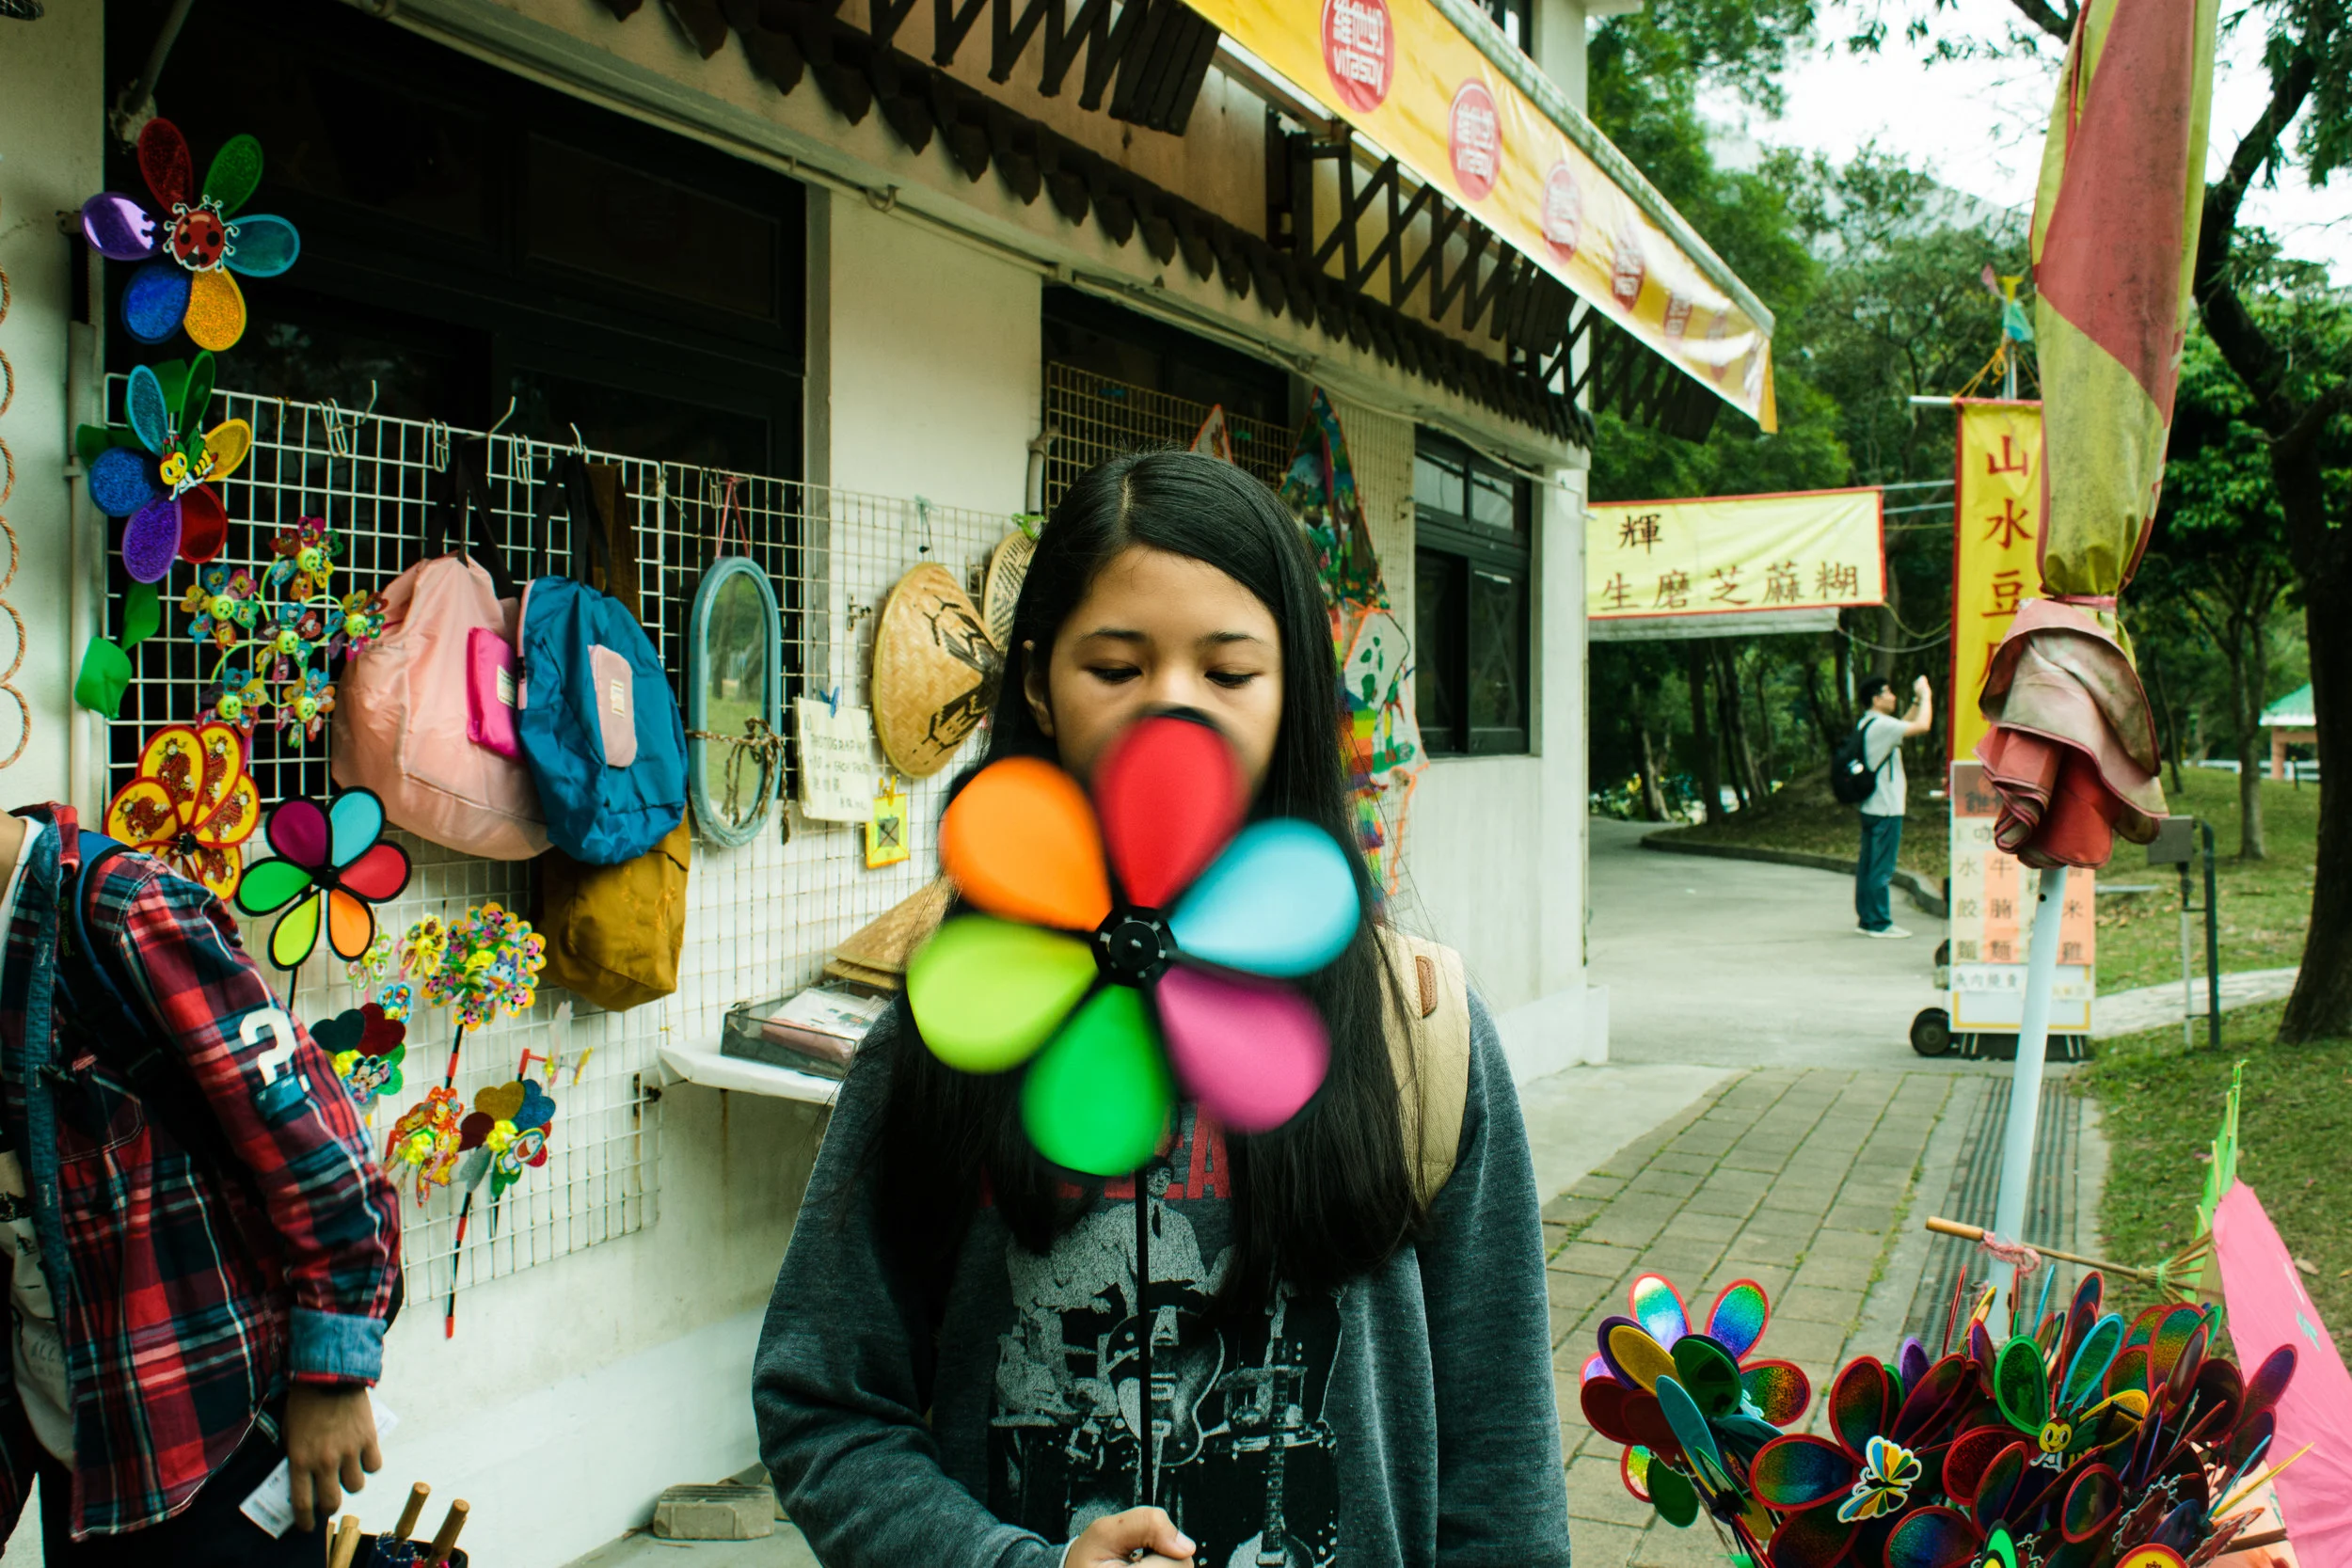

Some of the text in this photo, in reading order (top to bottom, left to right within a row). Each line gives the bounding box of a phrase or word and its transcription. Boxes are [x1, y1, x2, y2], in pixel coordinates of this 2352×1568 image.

[1618, 513, 1662, 555] 輝
[1978, 435, 2034, 687] 山水豆
